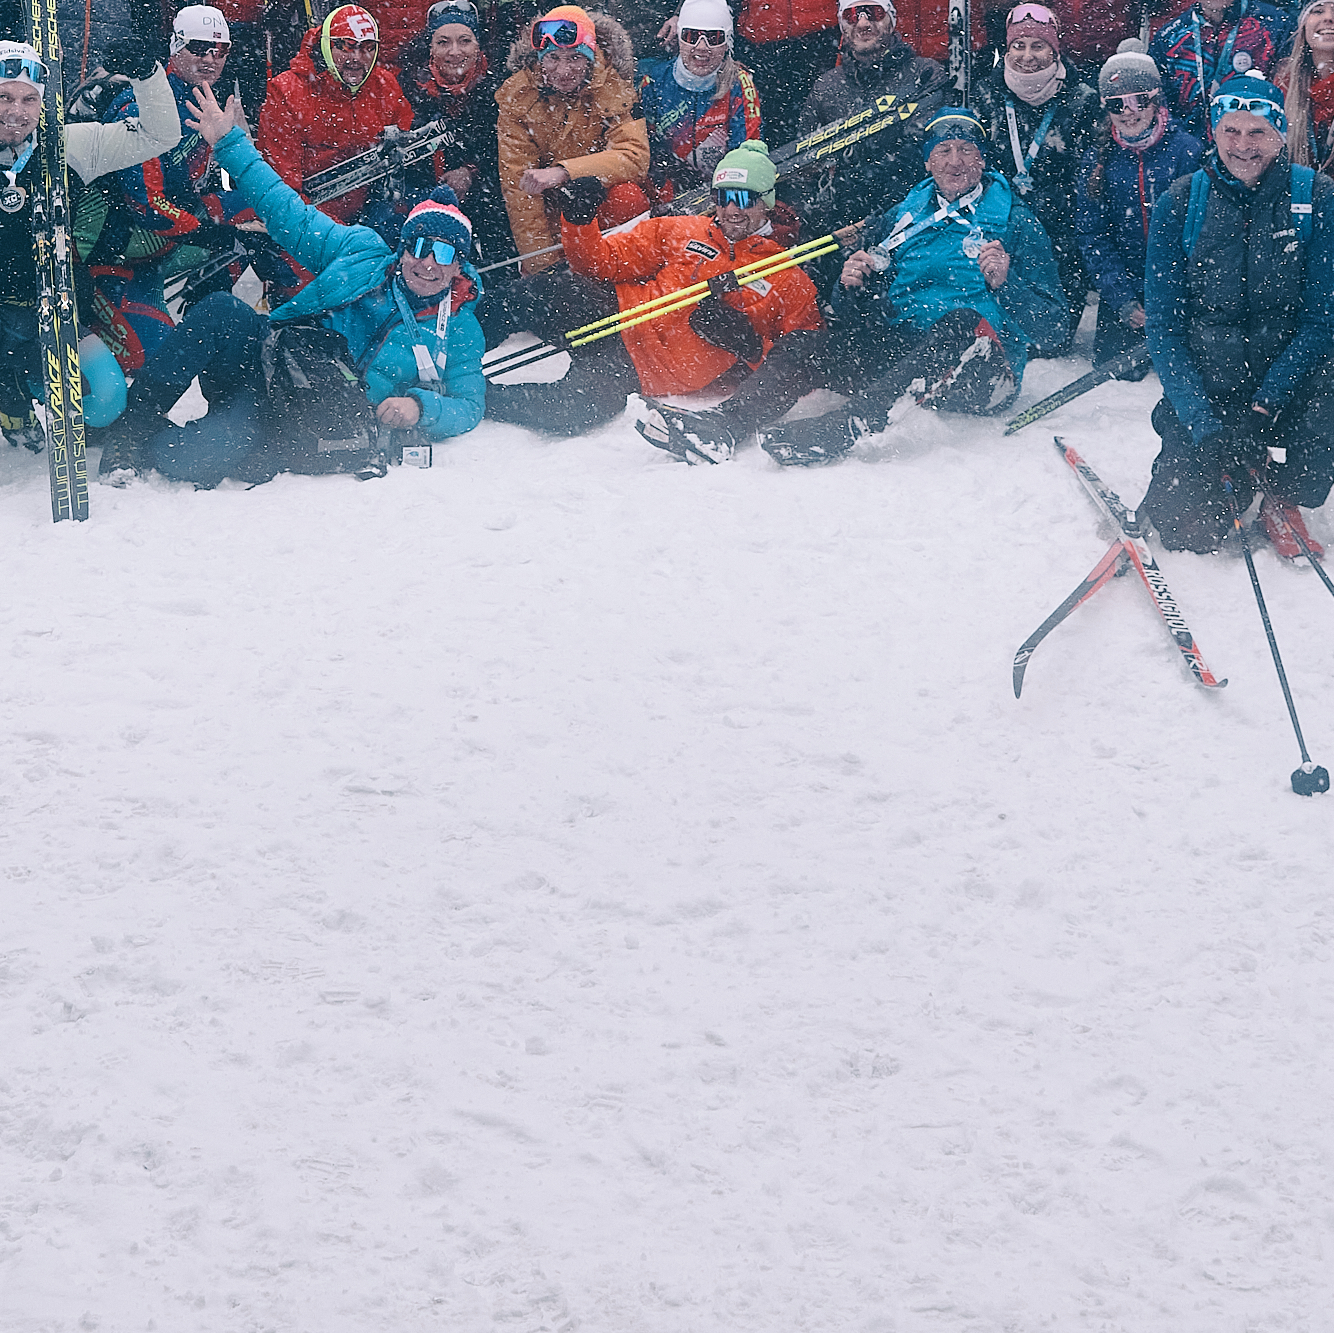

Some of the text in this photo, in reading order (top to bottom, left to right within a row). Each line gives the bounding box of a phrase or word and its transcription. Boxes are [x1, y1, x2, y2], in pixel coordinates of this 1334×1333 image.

[796, 109, 873, 153] FISCHER
[816, 115, 894, 159] FISCHER
[46, 349, 62, 419] RACE
[65, 343, 82, 414] RACE
[1144, 566, 1191, 634] ROSSIGNOL
